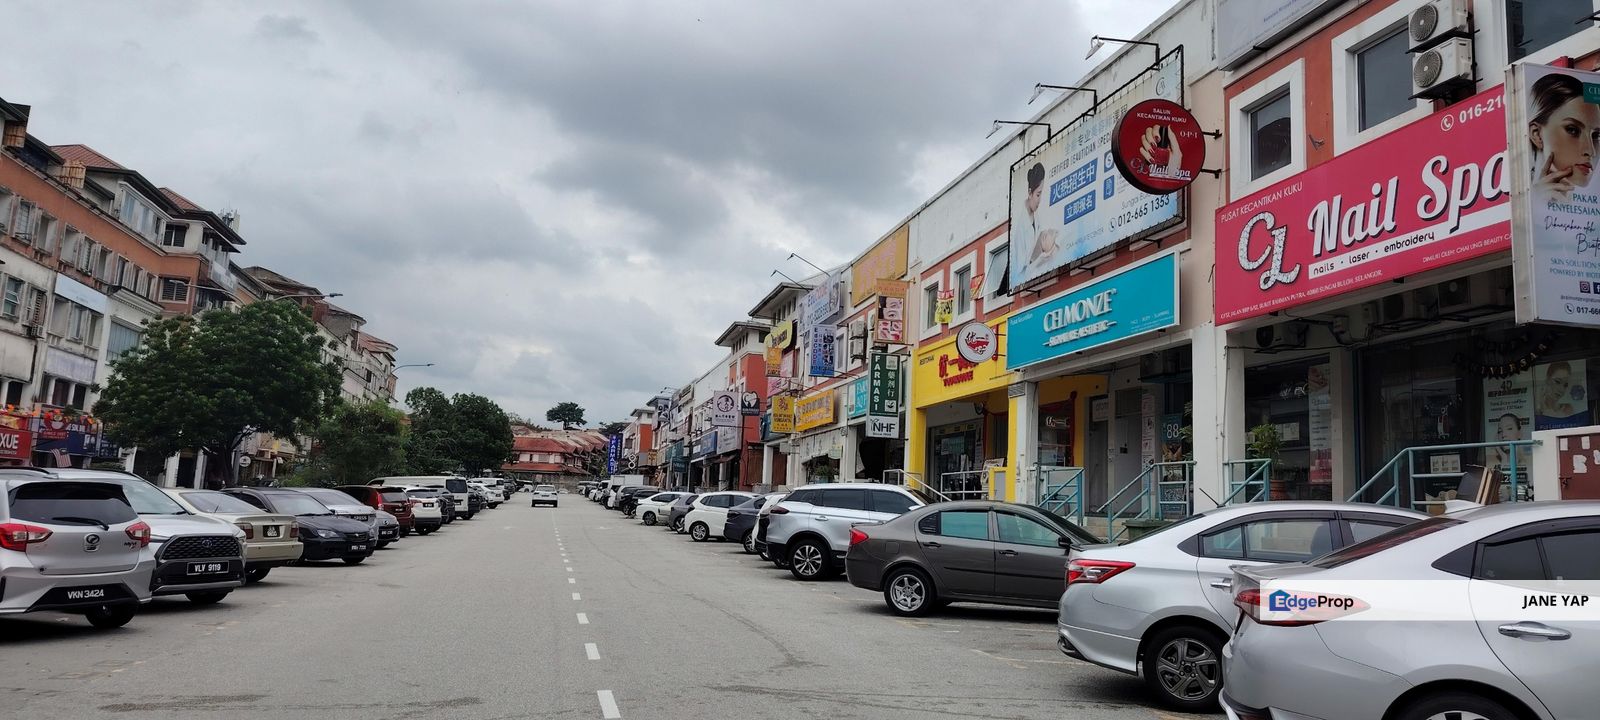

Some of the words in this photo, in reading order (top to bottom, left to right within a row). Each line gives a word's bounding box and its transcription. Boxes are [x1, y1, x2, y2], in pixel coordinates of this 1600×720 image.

[1136, 112, 1170, 121] KECANTIKAN
[1152, 107, 1171, 115] SALUN
[1149, 164, 1169, 176] Nail
[1052, 164, 1096, 201] 火热招生中
[1221, 210, 1240, 223] PUSAT
[1240, 190, 1282, 216] KECANTIKAN
[1284, 182, 1303, 197] KUKU
[1308, 176, 1398, 259] Nail
[1416, 150, 1512, 234] Spa
[1572, 194, 1598, 204] PAKAR
[1118, 202, 1148, 227] 012-665
[1150, 194, 1170, 212] 1353
[1484, 236, 1504, 248] BEAUTY
[1238, 211, 1300, 291] CL
[1314, 262, 1334, 276] nails
[1349, 251, 1370, 266] laser
[1384, 231, 1435, 254] embroidery
[1566, 258, 1597, 269] SOLUTION
[1550, 268, 1576, 277] POWERED
[1043, 292, 1113, 332] CELMONZE
[873, 422, 895, 432] NHF
[1166, 424, 1179, 438] 88
[195, 564, 206, 572] VLV
[208, 563, 221, 571] 9119
[67, 590, 83, 599] VKN
[84, 588, 104, 598] 3424
